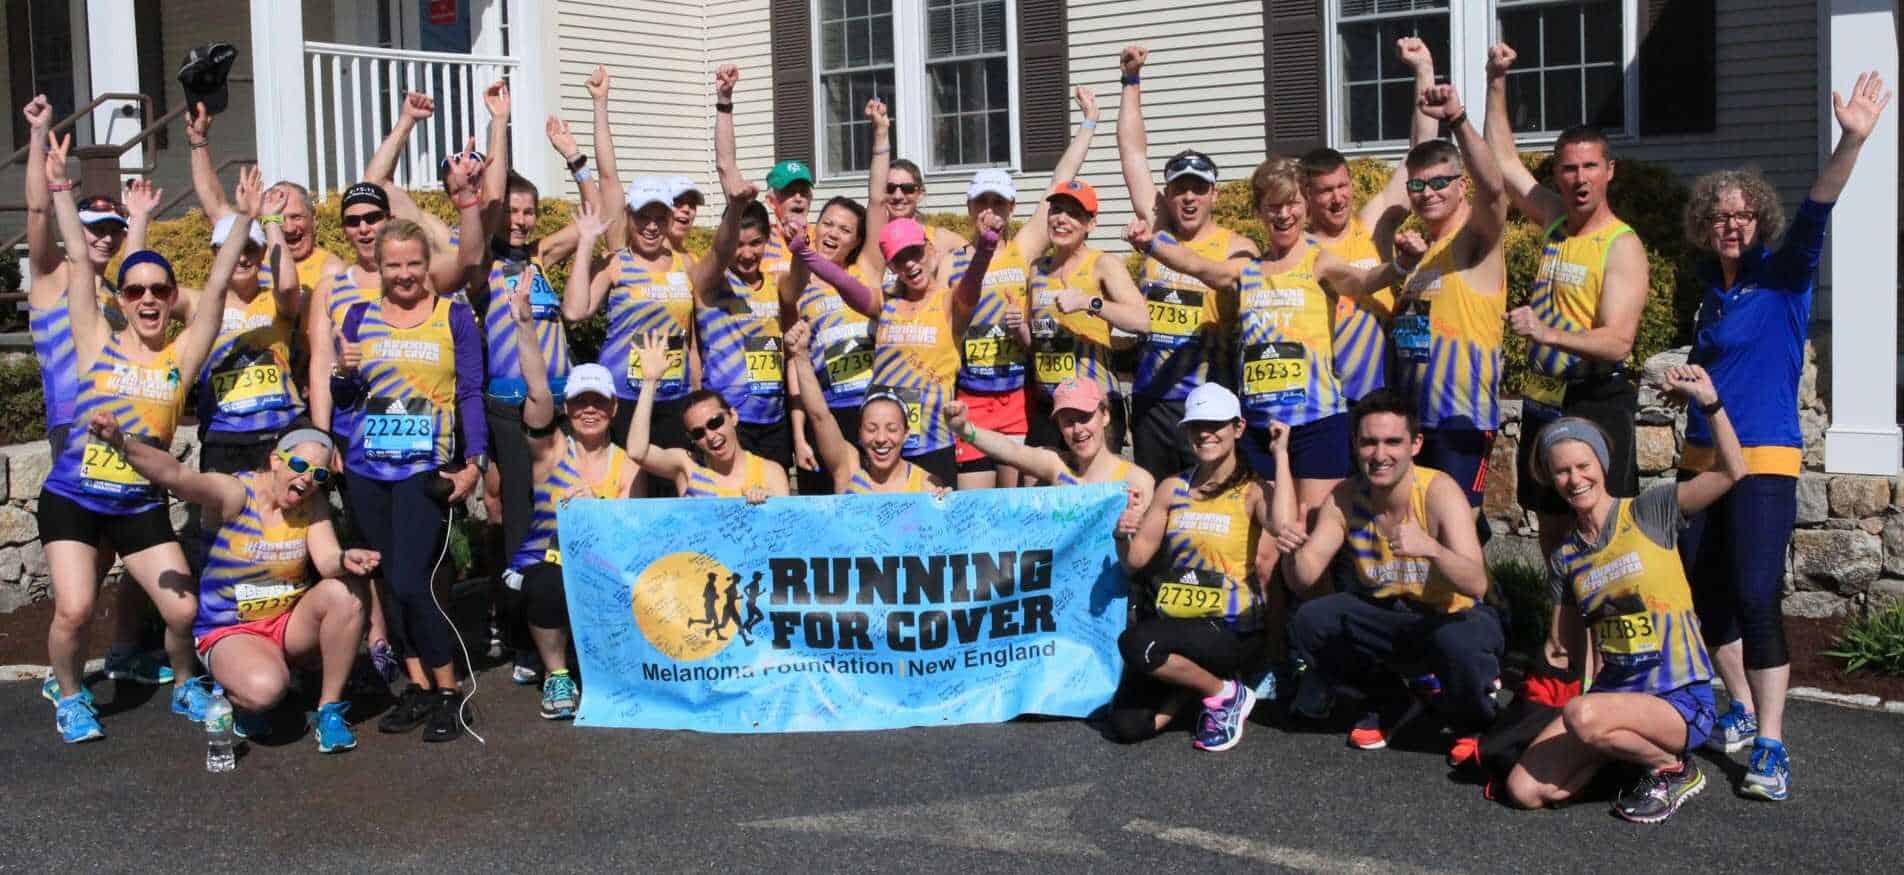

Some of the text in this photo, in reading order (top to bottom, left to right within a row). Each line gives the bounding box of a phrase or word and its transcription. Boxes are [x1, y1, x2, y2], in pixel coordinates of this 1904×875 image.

[1149, 303, 1199, 325] 27381
[1251, 311, 1294, 329] AMY
[749, 354, 783, 370] 273
[831, 353, 873, 375] 2739
[1037, 354, 1074, 372] 7380
[1246, 362, 1302, 383] 26233
[366, 418, 431, 437] 22228
[85, 448, 134, 471] 273
[768, 549, 1054, 605] RUNNING
[1160, 585, 1221, 608] 27392
[769, 594, 1057, 653] FOR COVER
[642, 662, 754, 682] Melanoma
[909, 655, 957, 677] New
[965, 640, 1056, 668] England
